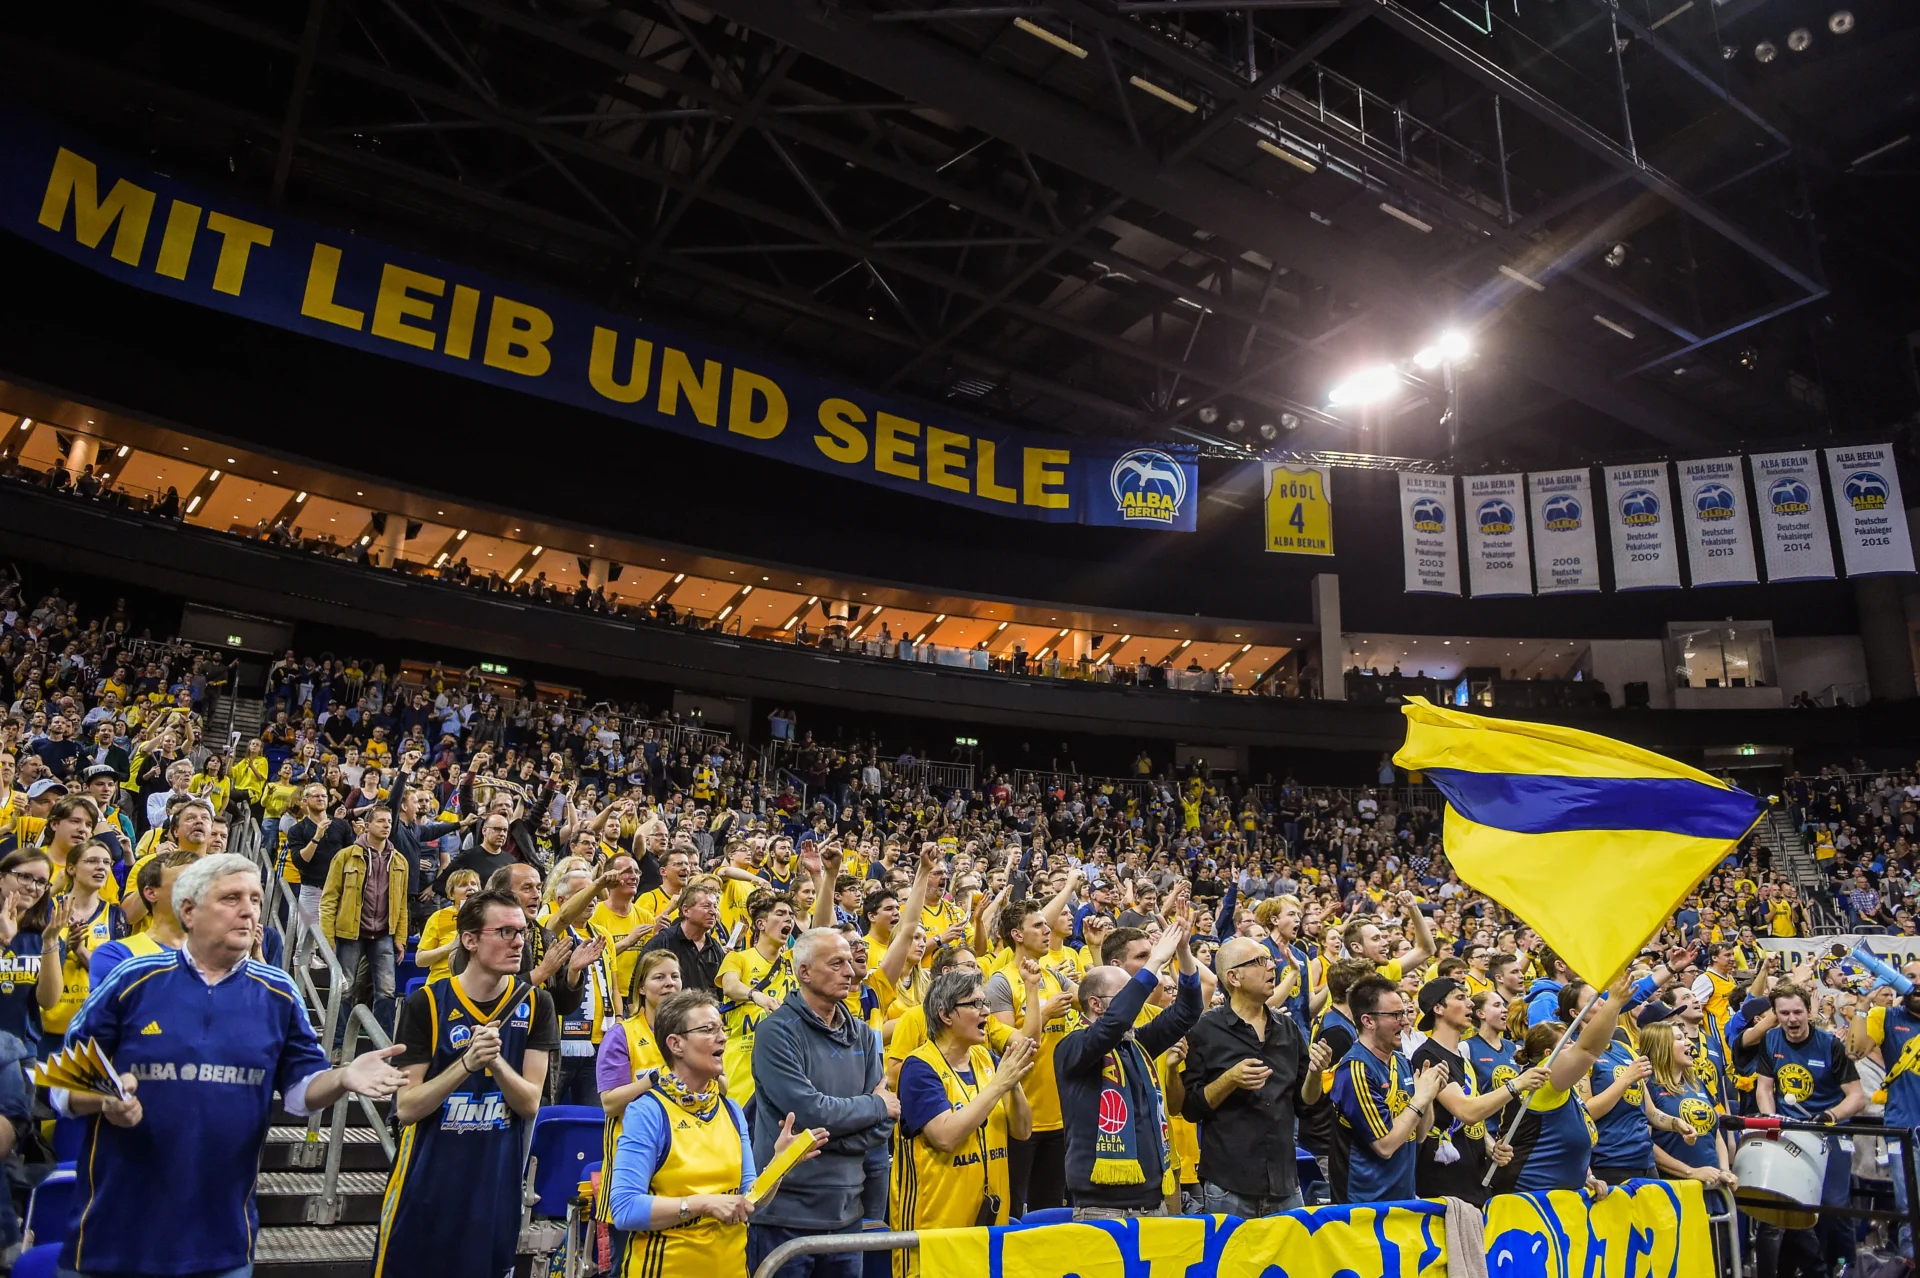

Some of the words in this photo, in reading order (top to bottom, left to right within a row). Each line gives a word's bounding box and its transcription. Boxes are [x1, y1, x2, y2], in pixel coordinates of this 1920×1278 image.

[38, 146, 273, 296] MIT
[301, 242, 554, 376] LEIB
[588, 326, 788, 440] UND
[814, 398, 1070, 509] SEELE
[1837, 454, 1855, 462] ALBA
[1857, 451, 1884, 460] BERLIN
[1761, 460, 1780, 469] ALBA
[1781, 457, 1808, 467] BERLIN
[1686, 466, 1704, 475] ALBA
[1707, 463, 1734, 472] BERLIN
[1613, 471, 1632, 480] ALBA
[1633, 469, 1659, 479] BERLIN
[1407, 479, 1422, 487] ALBA
[1424, 480, 1446, 488] BERLIN
[1472, 482, 1488, 490] ALBA
[1491, 480, 1515, 488] BERLIN
[1537, 478, 1558, 486] ALBA
[1559, 475, 1582, 484] BERLIN
[1280, 480, 1315, 500] RÖDL
[1122, 491, 1174, 511] ALBA
[1852, 495, 1885, 505] ALBA
[1775, 503, 1807, 512] ALBA
[1127, 507, 1169, 519] BERLIN
[1700, 509, 1733, 518] ALBA
[1289, 503, 1305, 534] 4
[1625, 514, 1657, 523] ALBA
[1855, 517, 1888, 525] Deutscher
[1415, 521, 1443, 532] ALBA
[1481, 523, 1512, 533] ALBA
[1547, 520, 1579, 529] ALBA
[1777, 522, 1810, 531] Deutscher
[1702, 527, 1734, 537] Deutscher
[1855, 526, 1892, 535] Pokalsieger
[1626, 531, 1658, 541] Deutscher
[1701, 536, 1737, 546] Pokalsieger
[1777, 531, 1813, 541] Pokalsieger
[1274, 536, 1294, 546] ALBA
[1297, 537, 1325, 549] BERLIN
[1416, 538, 1444, 548] Deutscher
[1482, 541, 1513, 549] Deutscher
[1626, 541, 1662, 551] Pokalsieger
[1862, 537, 1890, 546] 2016
[1783, 542, 1811, 552] 2014
[1415, 548, 1446, 558] Pokalsieger
[1481, 550, 1516, 559] Pokalsieger
[1631, 552, 1660, 562] 2009
[1708, 548, 1734, 557] 2013
[1419, 559, 1444, 568] 2003
[1486, 561, 1513, 570] 2006
[1552, 557, 1580, 566] 2008
[1418, 569, 1445, 578] Deutscher
[1551, 567, 1582, 576] Deutscher
[1422, 578, 1443, 586] Meister
[1556, 577, 1579, 585] Meister
[0, 955, 41, 972] RLIN
[130, 1062, 178, 1080] ALBA
[198, 1063, 265, 1085] BERLIN
[1097, 1134, 1122, 1143] ALBA
[1096, 1143, 1125, 1153] BERLIN
